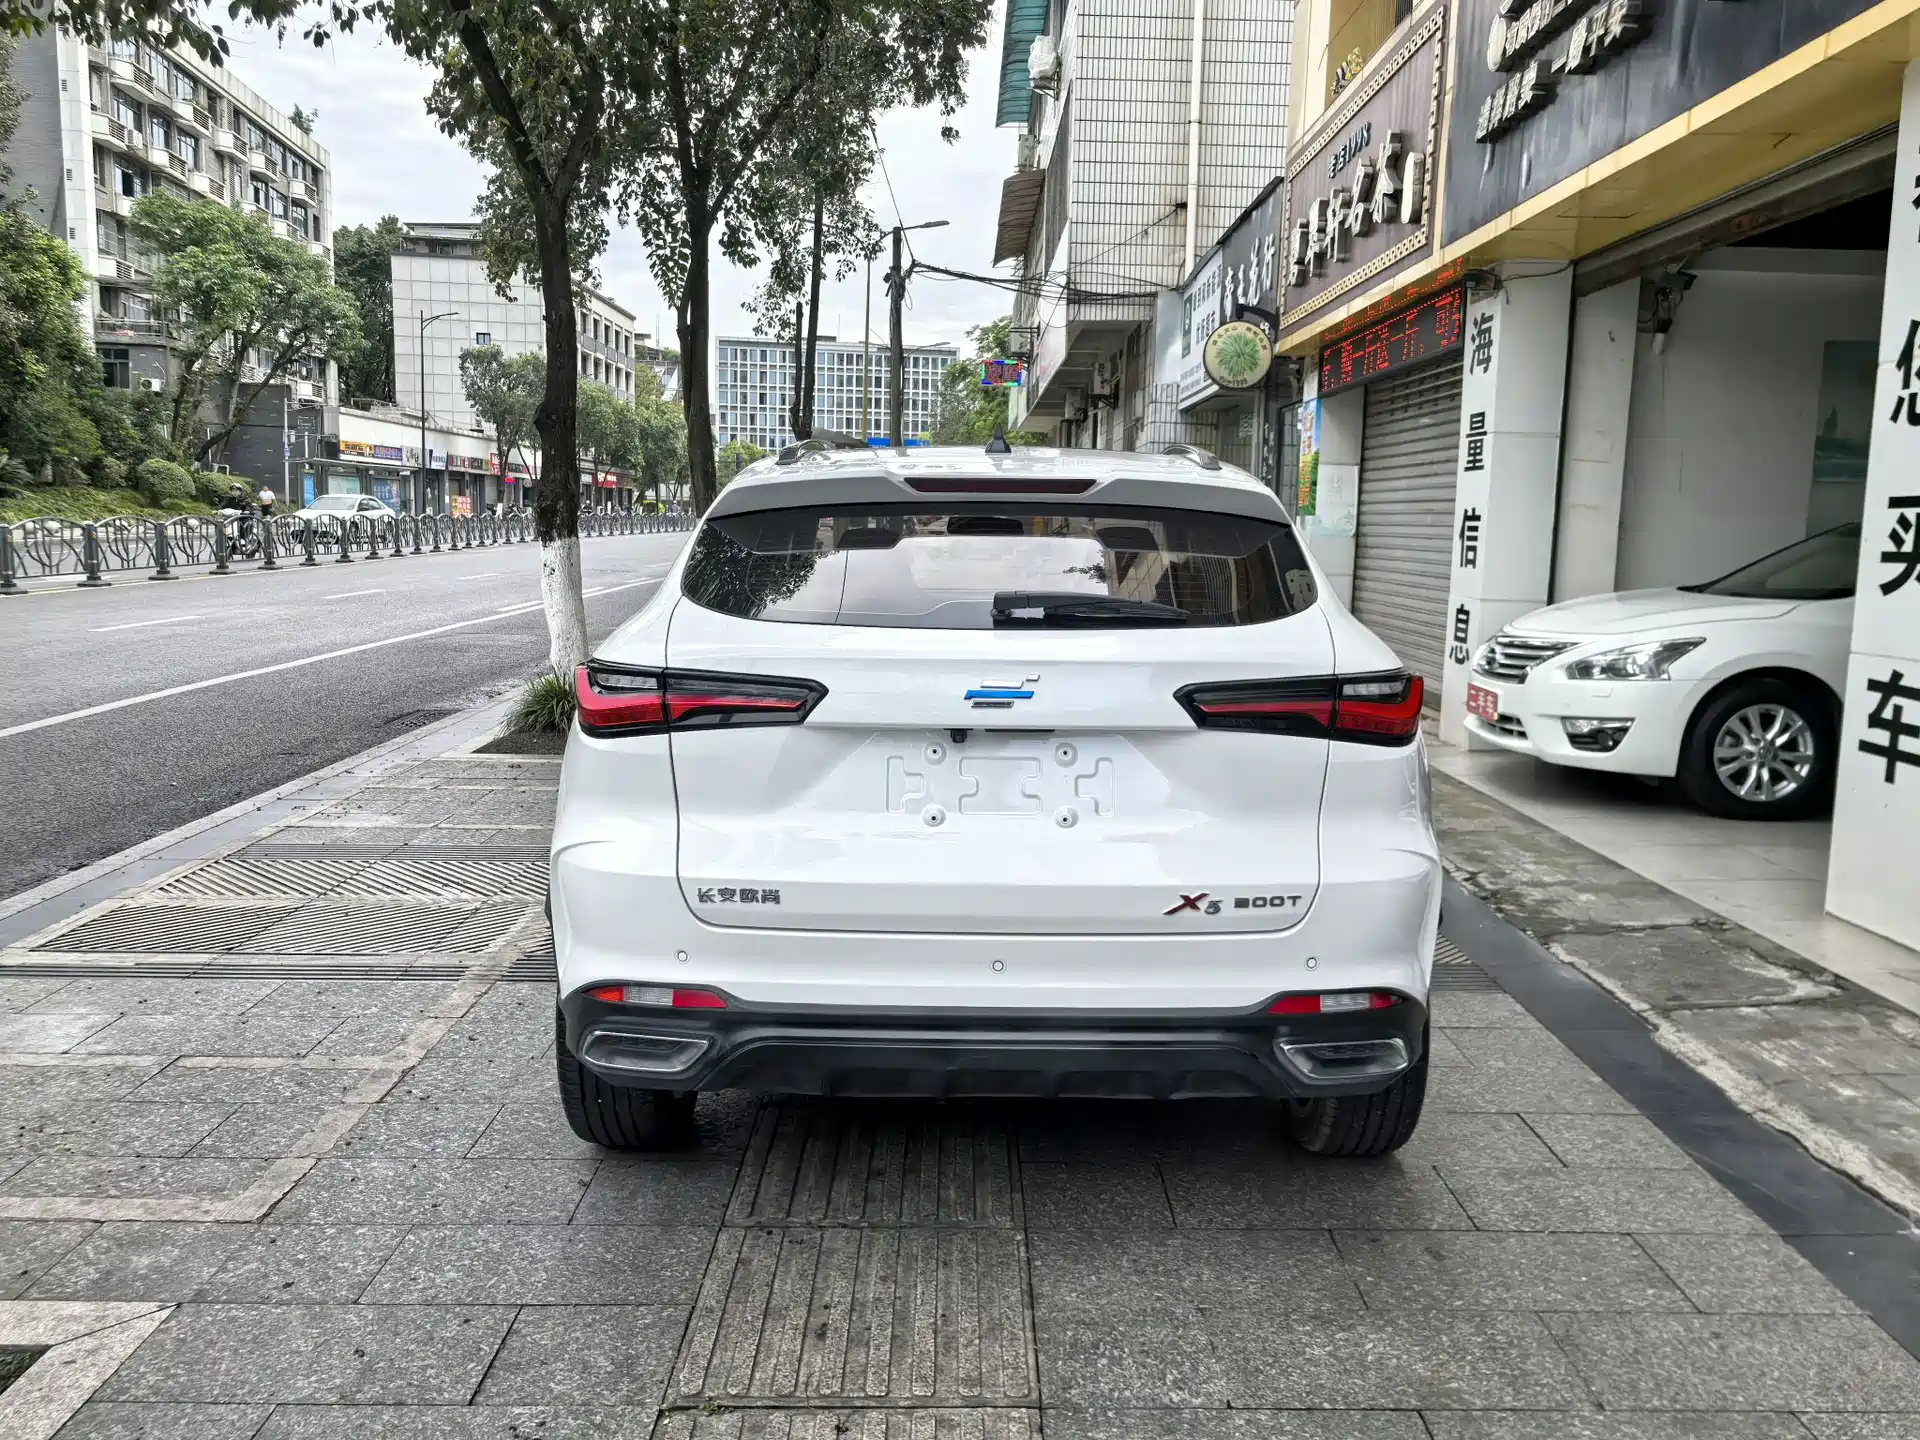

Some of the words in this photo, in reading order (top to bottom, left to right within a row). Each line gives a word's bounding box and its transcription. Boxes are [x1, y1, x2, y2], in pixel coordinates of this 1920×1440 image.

[1447, 311, 1495, 666] 海量信息
[1468, 689, 1495, 717] 二手车
[696, 887, 781, 904] 长安欧尚
[1162, 892, 1223, 915] X5
